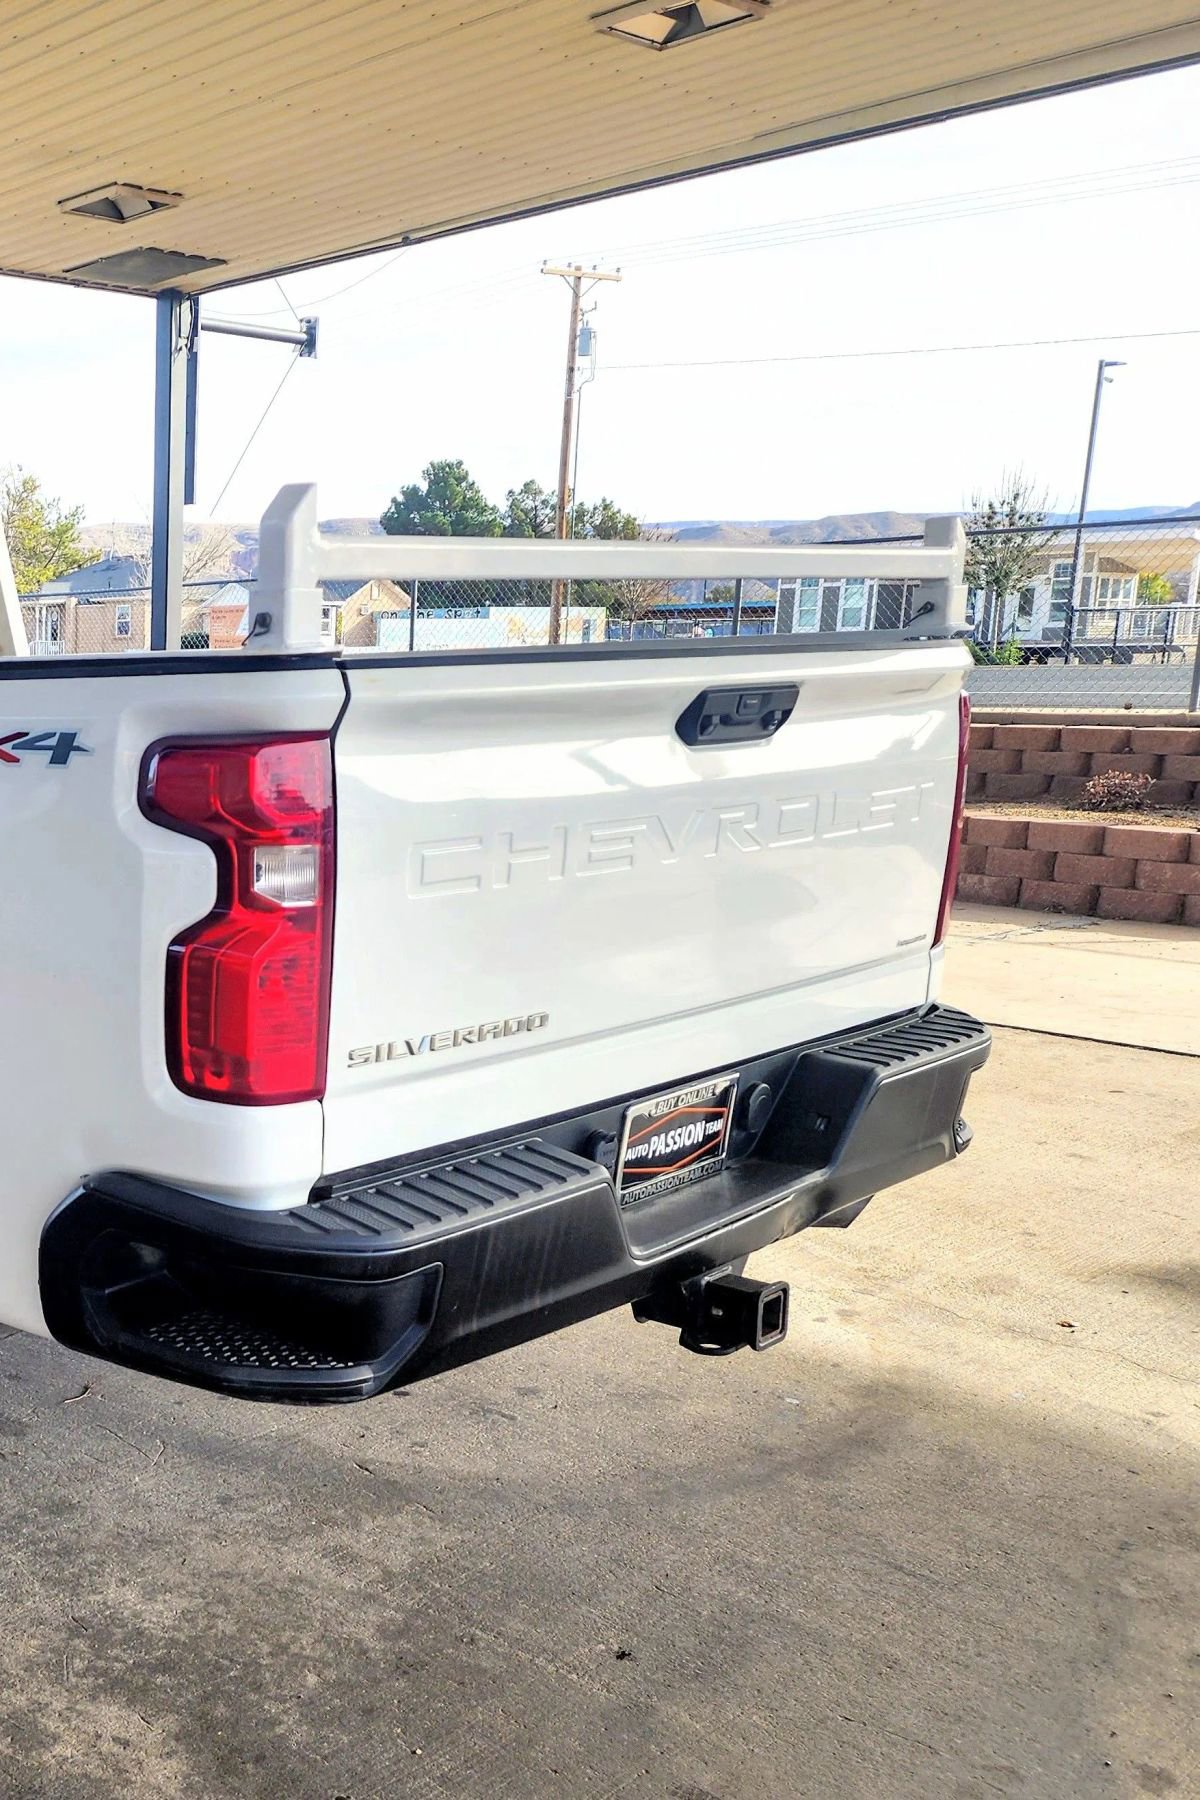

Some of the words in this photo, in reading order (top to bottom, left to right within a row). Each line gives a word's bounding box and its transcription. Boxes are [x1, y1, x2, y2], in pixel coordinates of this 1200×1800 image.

[409, 609, 434, 620] he
[408, 782, 935, 899] CHEVROLET
[347, 1011, 550, 1068] SILVERADO
[656, 1098, 677, 1114] BUY
[677, 1084, 715, 1106] ONLINE
[625, 1143, 649, 1161] AUTO
[648, 1120, 706, 1159] PASSION
[704, 1118, 724, 1136] TEAM
[622, 1161, 721, 1205] AUTOPASSIONTEAM.COM
